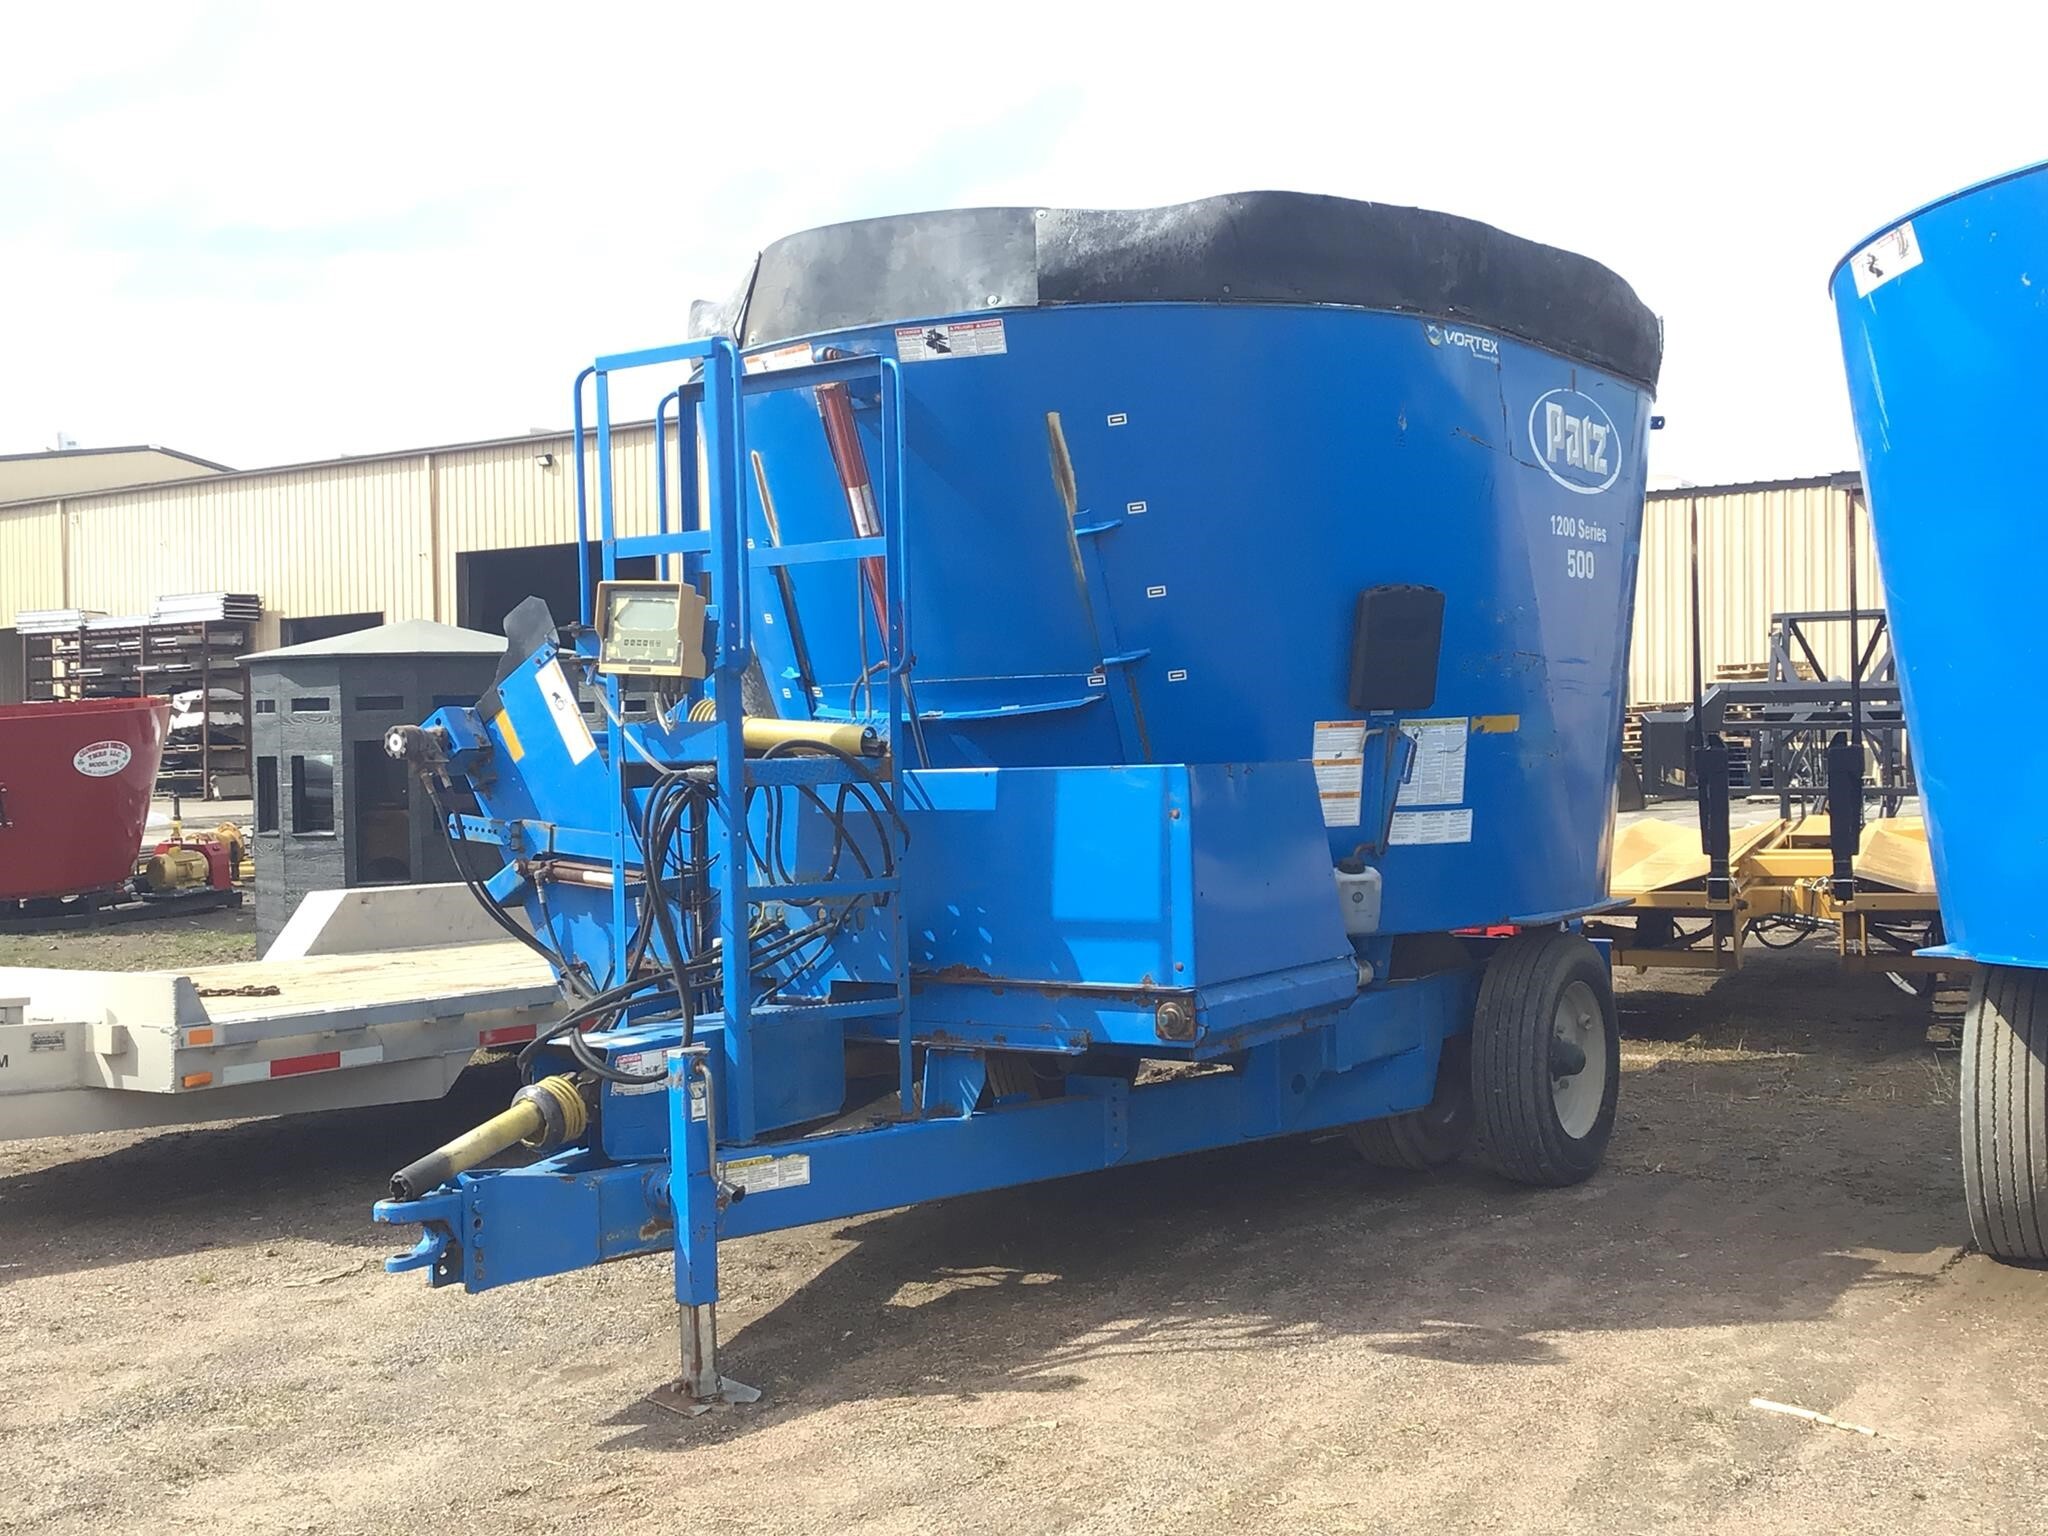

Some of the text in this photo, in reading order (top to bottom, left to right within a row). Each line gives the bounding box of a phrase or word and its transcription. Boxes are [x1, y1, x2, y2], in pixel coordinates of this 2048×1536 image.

[1545, 401, 1608, 475] Patz
[1550, 514, 1607, 543] 1200 Series
[1567, 549, 1595, 580] 500
